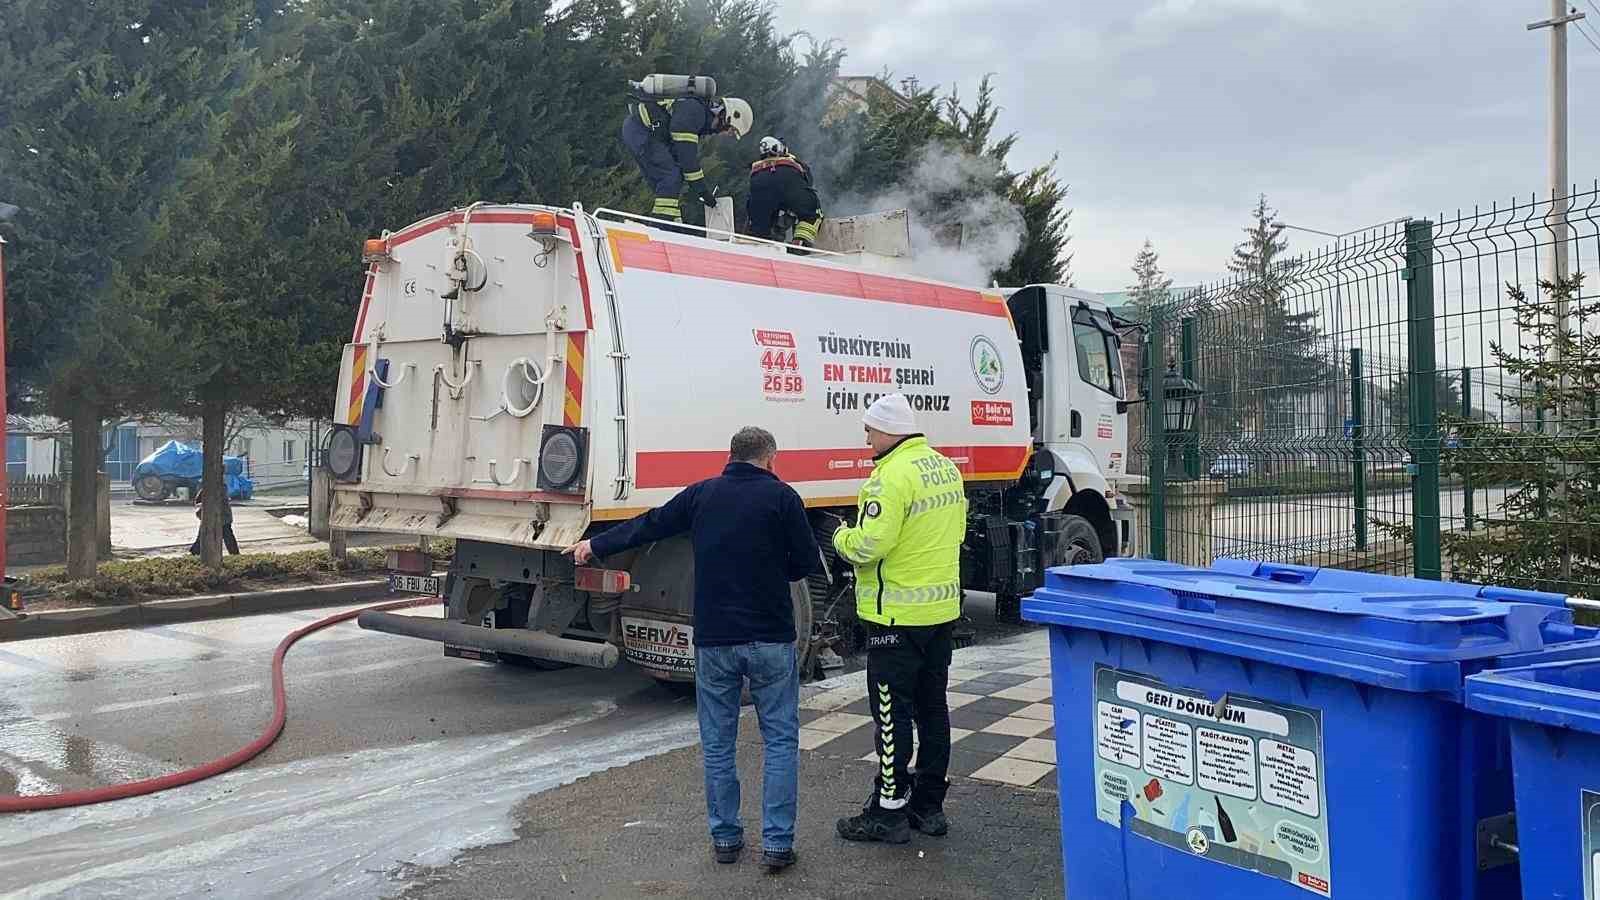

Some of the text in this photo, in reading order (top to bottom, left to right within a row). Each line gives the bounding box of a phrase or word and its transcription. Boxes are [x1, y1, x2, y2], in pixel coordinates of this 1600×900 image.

[818, 332, 911, 359] TÜRKİYE'NİN
[761, 350, 798, 371] 444
[823, 362, 934, 389] EN TEMİZ ŞEHRİ
[826, 387, 858, 415] İÇİN
[921, 468, 958, 488] POLİS
[1146, 691, 1245, 724] GERİ DÖNÜÜM
